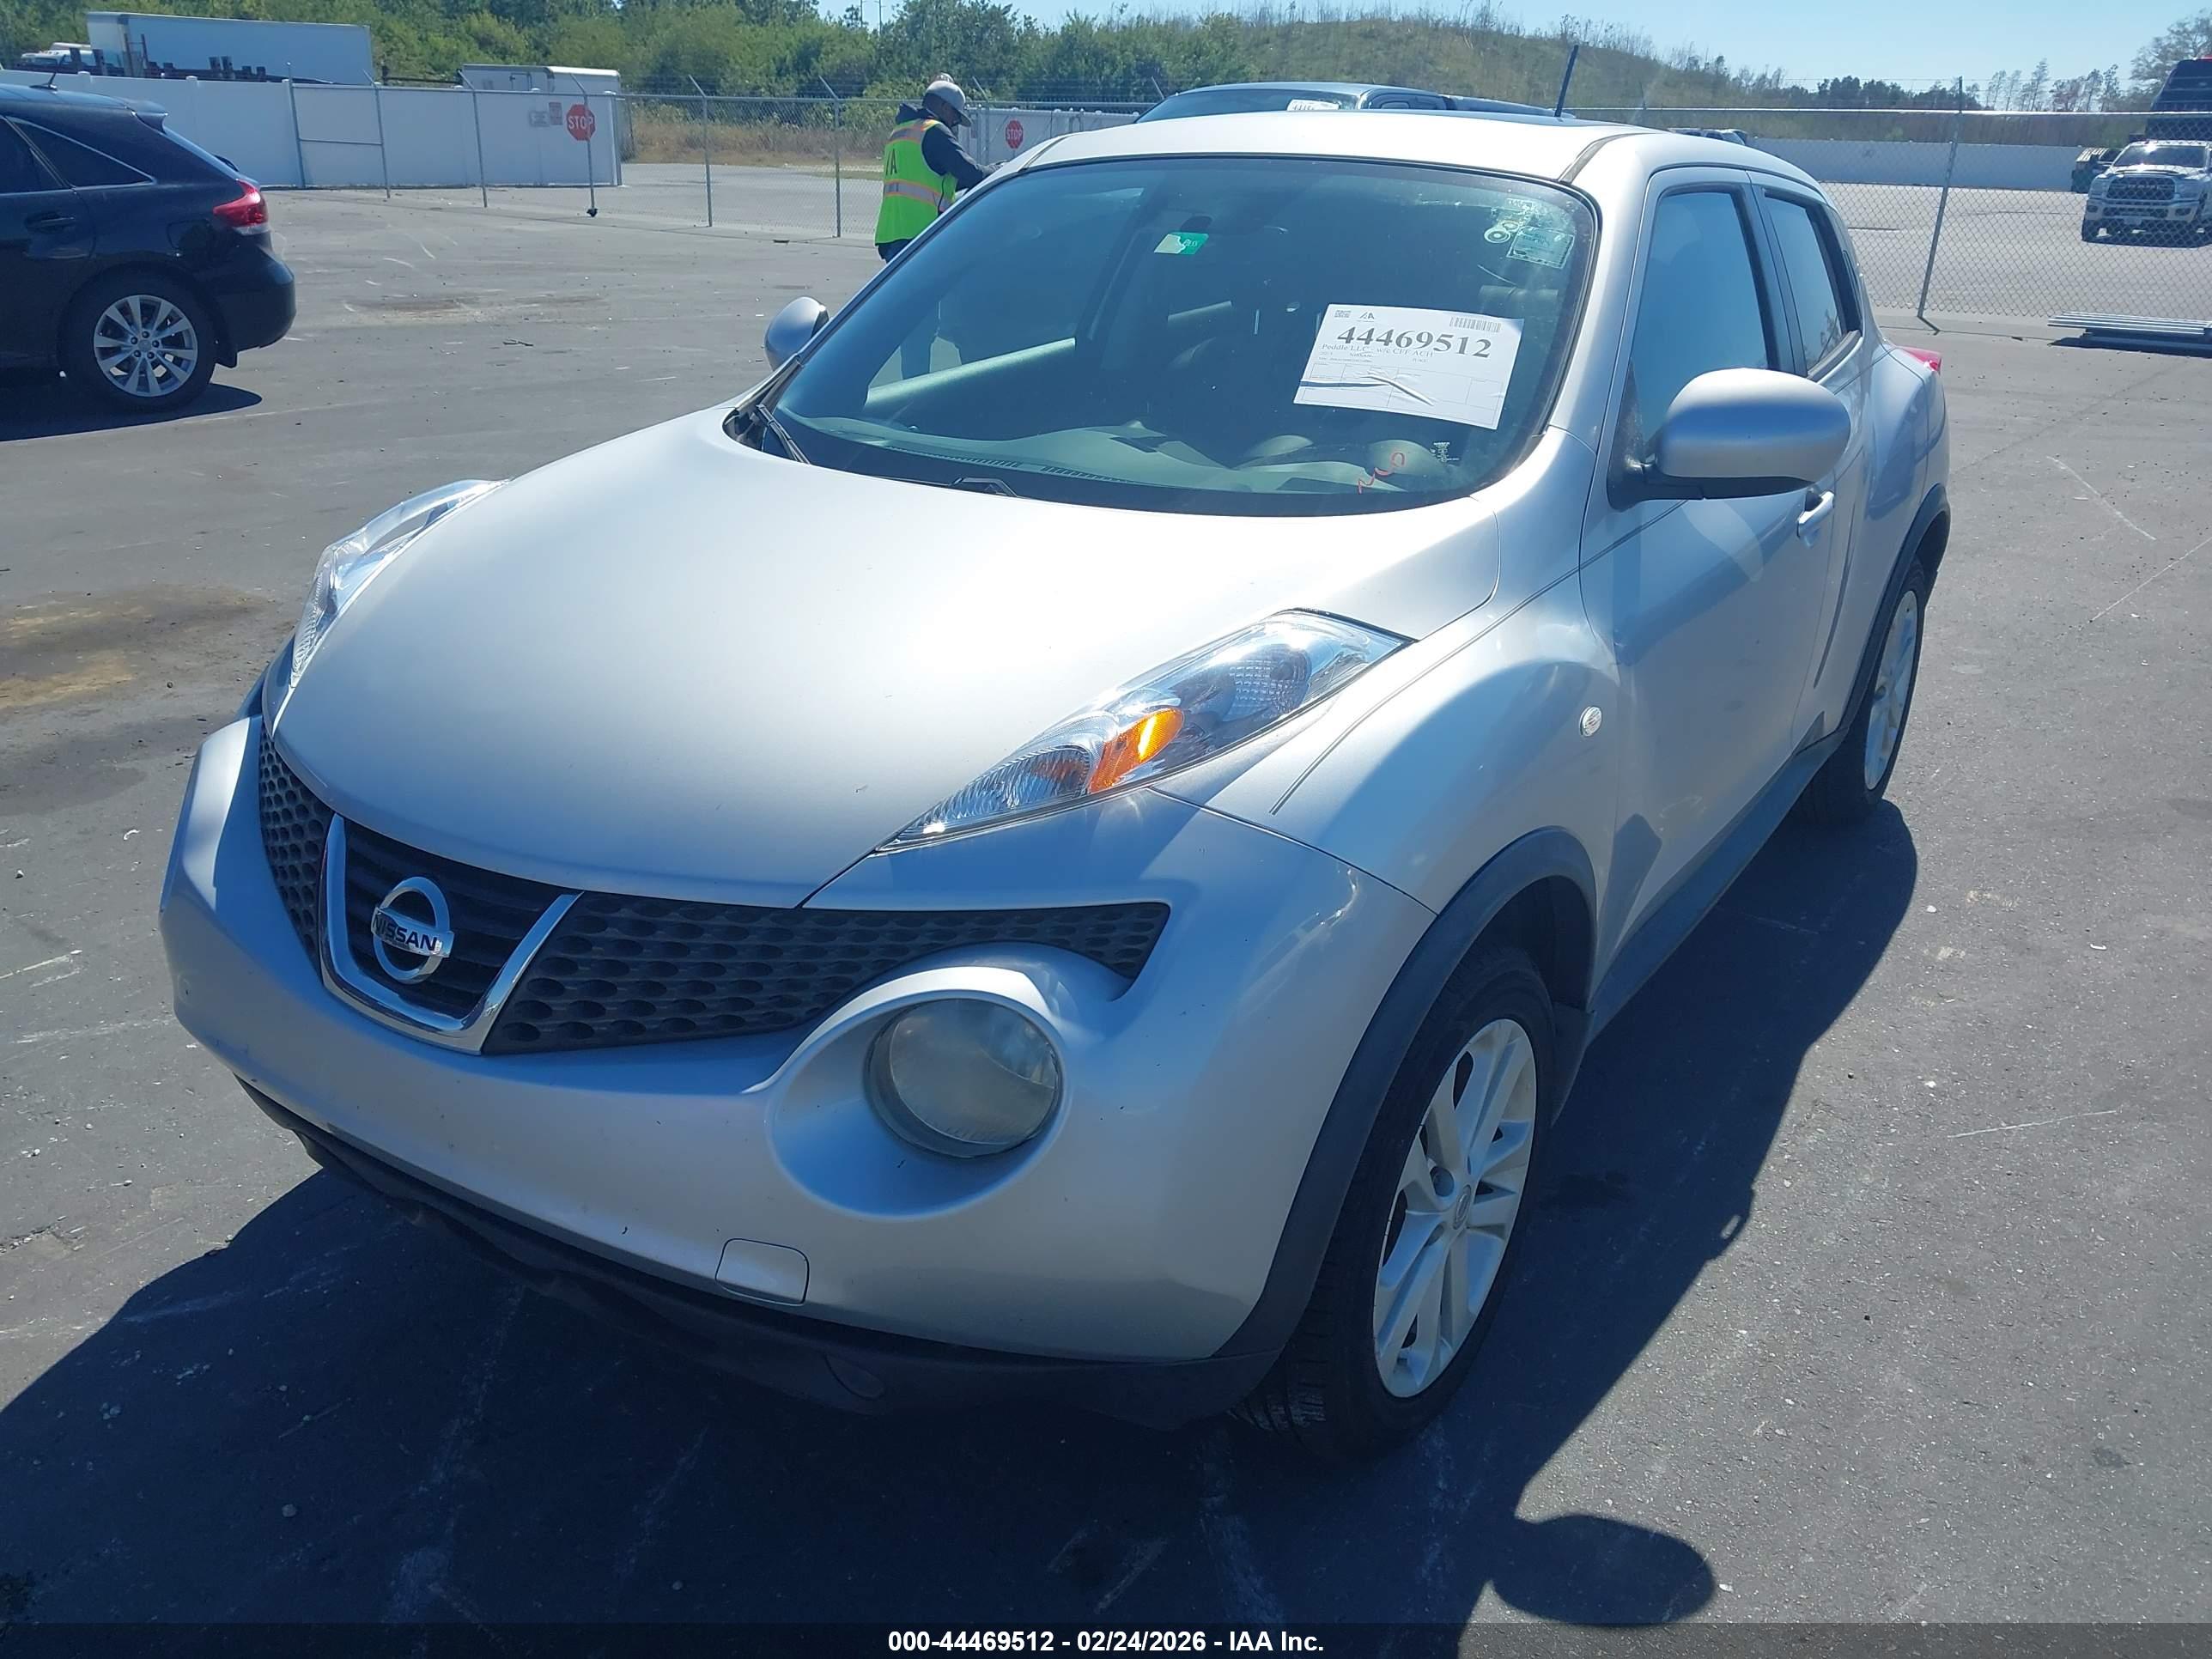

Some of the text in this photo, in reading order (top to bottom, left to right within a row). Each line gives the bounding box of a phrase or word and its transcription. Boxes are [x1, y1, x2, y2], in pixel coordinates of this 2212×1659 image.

[568, 115, 593, 130] STOP
[1006, 129, 1024, 141] STOP
[1336, 326, 1492, 358] 44469512
[373, 914, 438, 951] NISSAN
